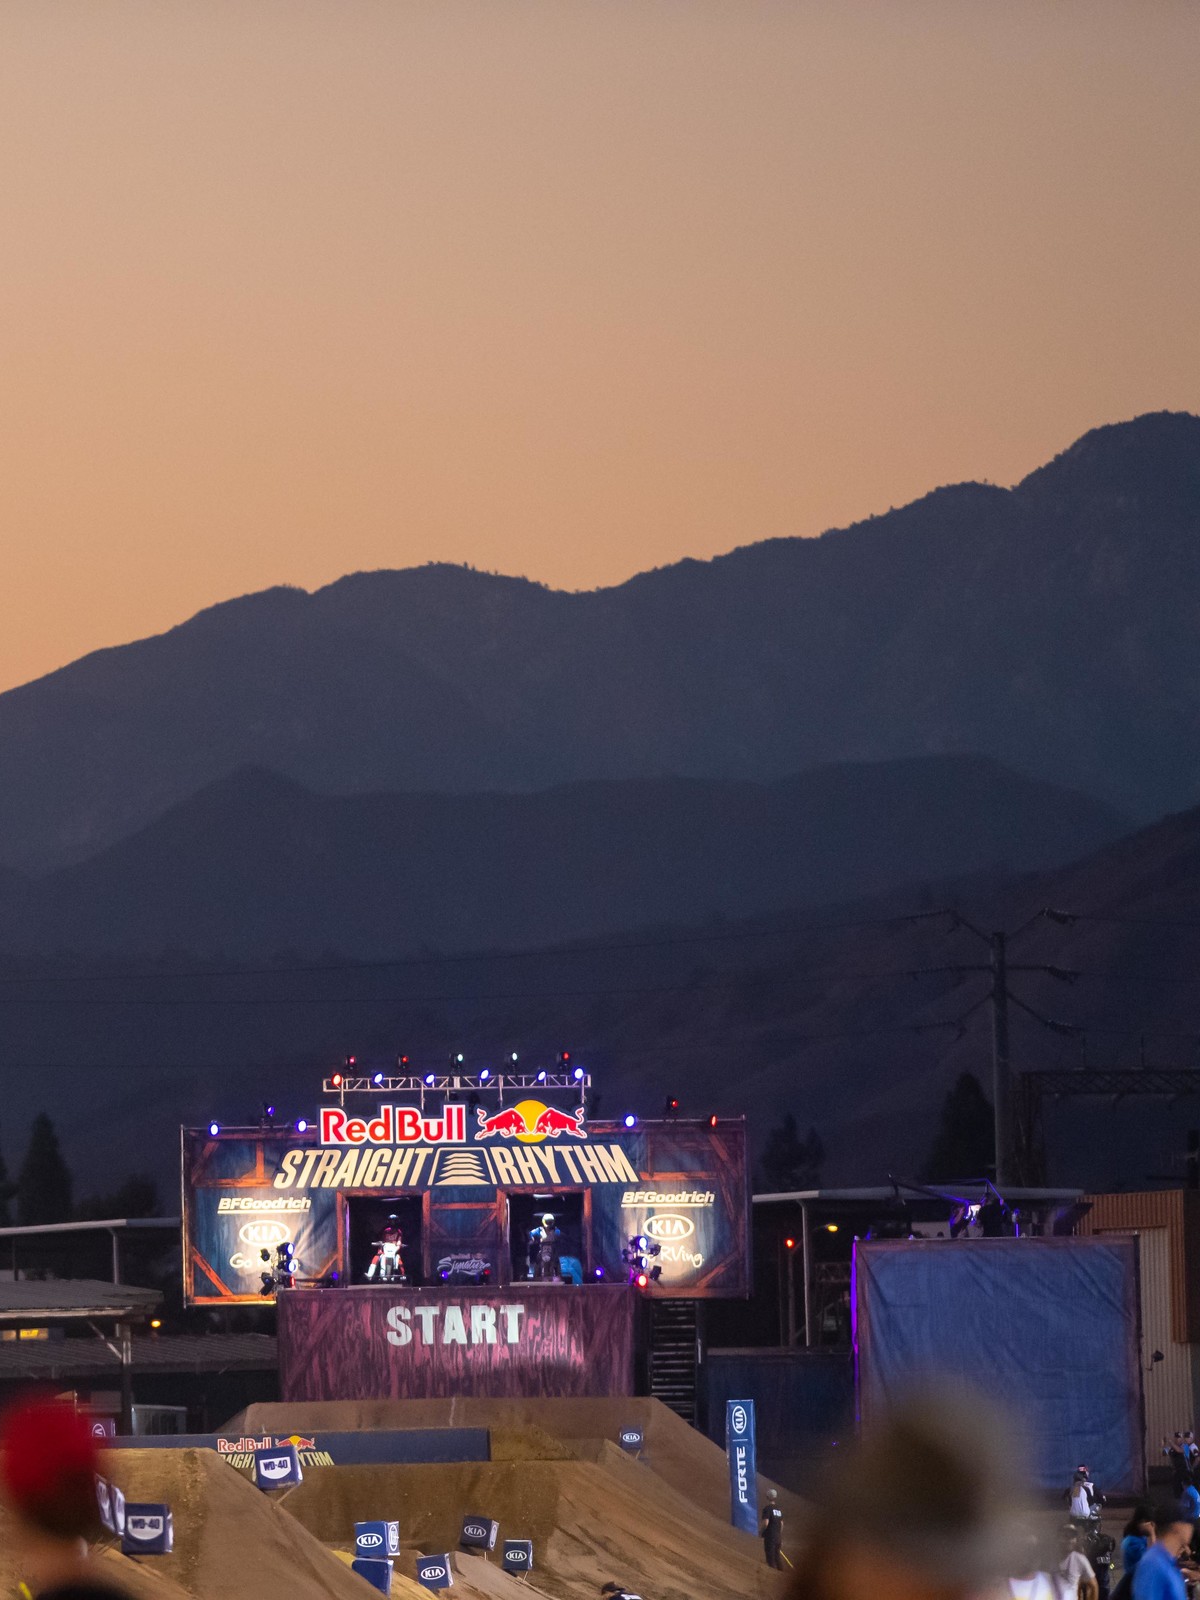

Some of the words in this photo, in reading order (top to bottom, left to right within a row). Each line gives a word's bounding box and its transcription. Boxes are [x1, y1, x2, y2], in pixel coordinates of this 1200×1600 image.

[321, 1105, 393, 1144] Red
[396, 1105, 466, 1143] Bull
[273, 1148, 433, 1189] STRAIGHT
[490, 1145, 640, 1184] RHYTHM
[218, 1197, 312, 1210] BFGoodrich
[622, 1191, 715, 1204] BFGoodrich
[247, 1225, 281, 1241] KIA
[651, 1219, 686, 1235] KIA
[386, 1304, 525, 1346] START
[734, 1410, 744, 1430] KIA
[217, 1439, 244, 1452] Red
[246, 1437, 272, 1452] Bull
[263, 1459, 288, 1471] WD-40
[736, 1446, 748, 1503] FORTE
[360, 1536, 379, 1545] KIA
[424, 1568, 442, 1578] KIA
